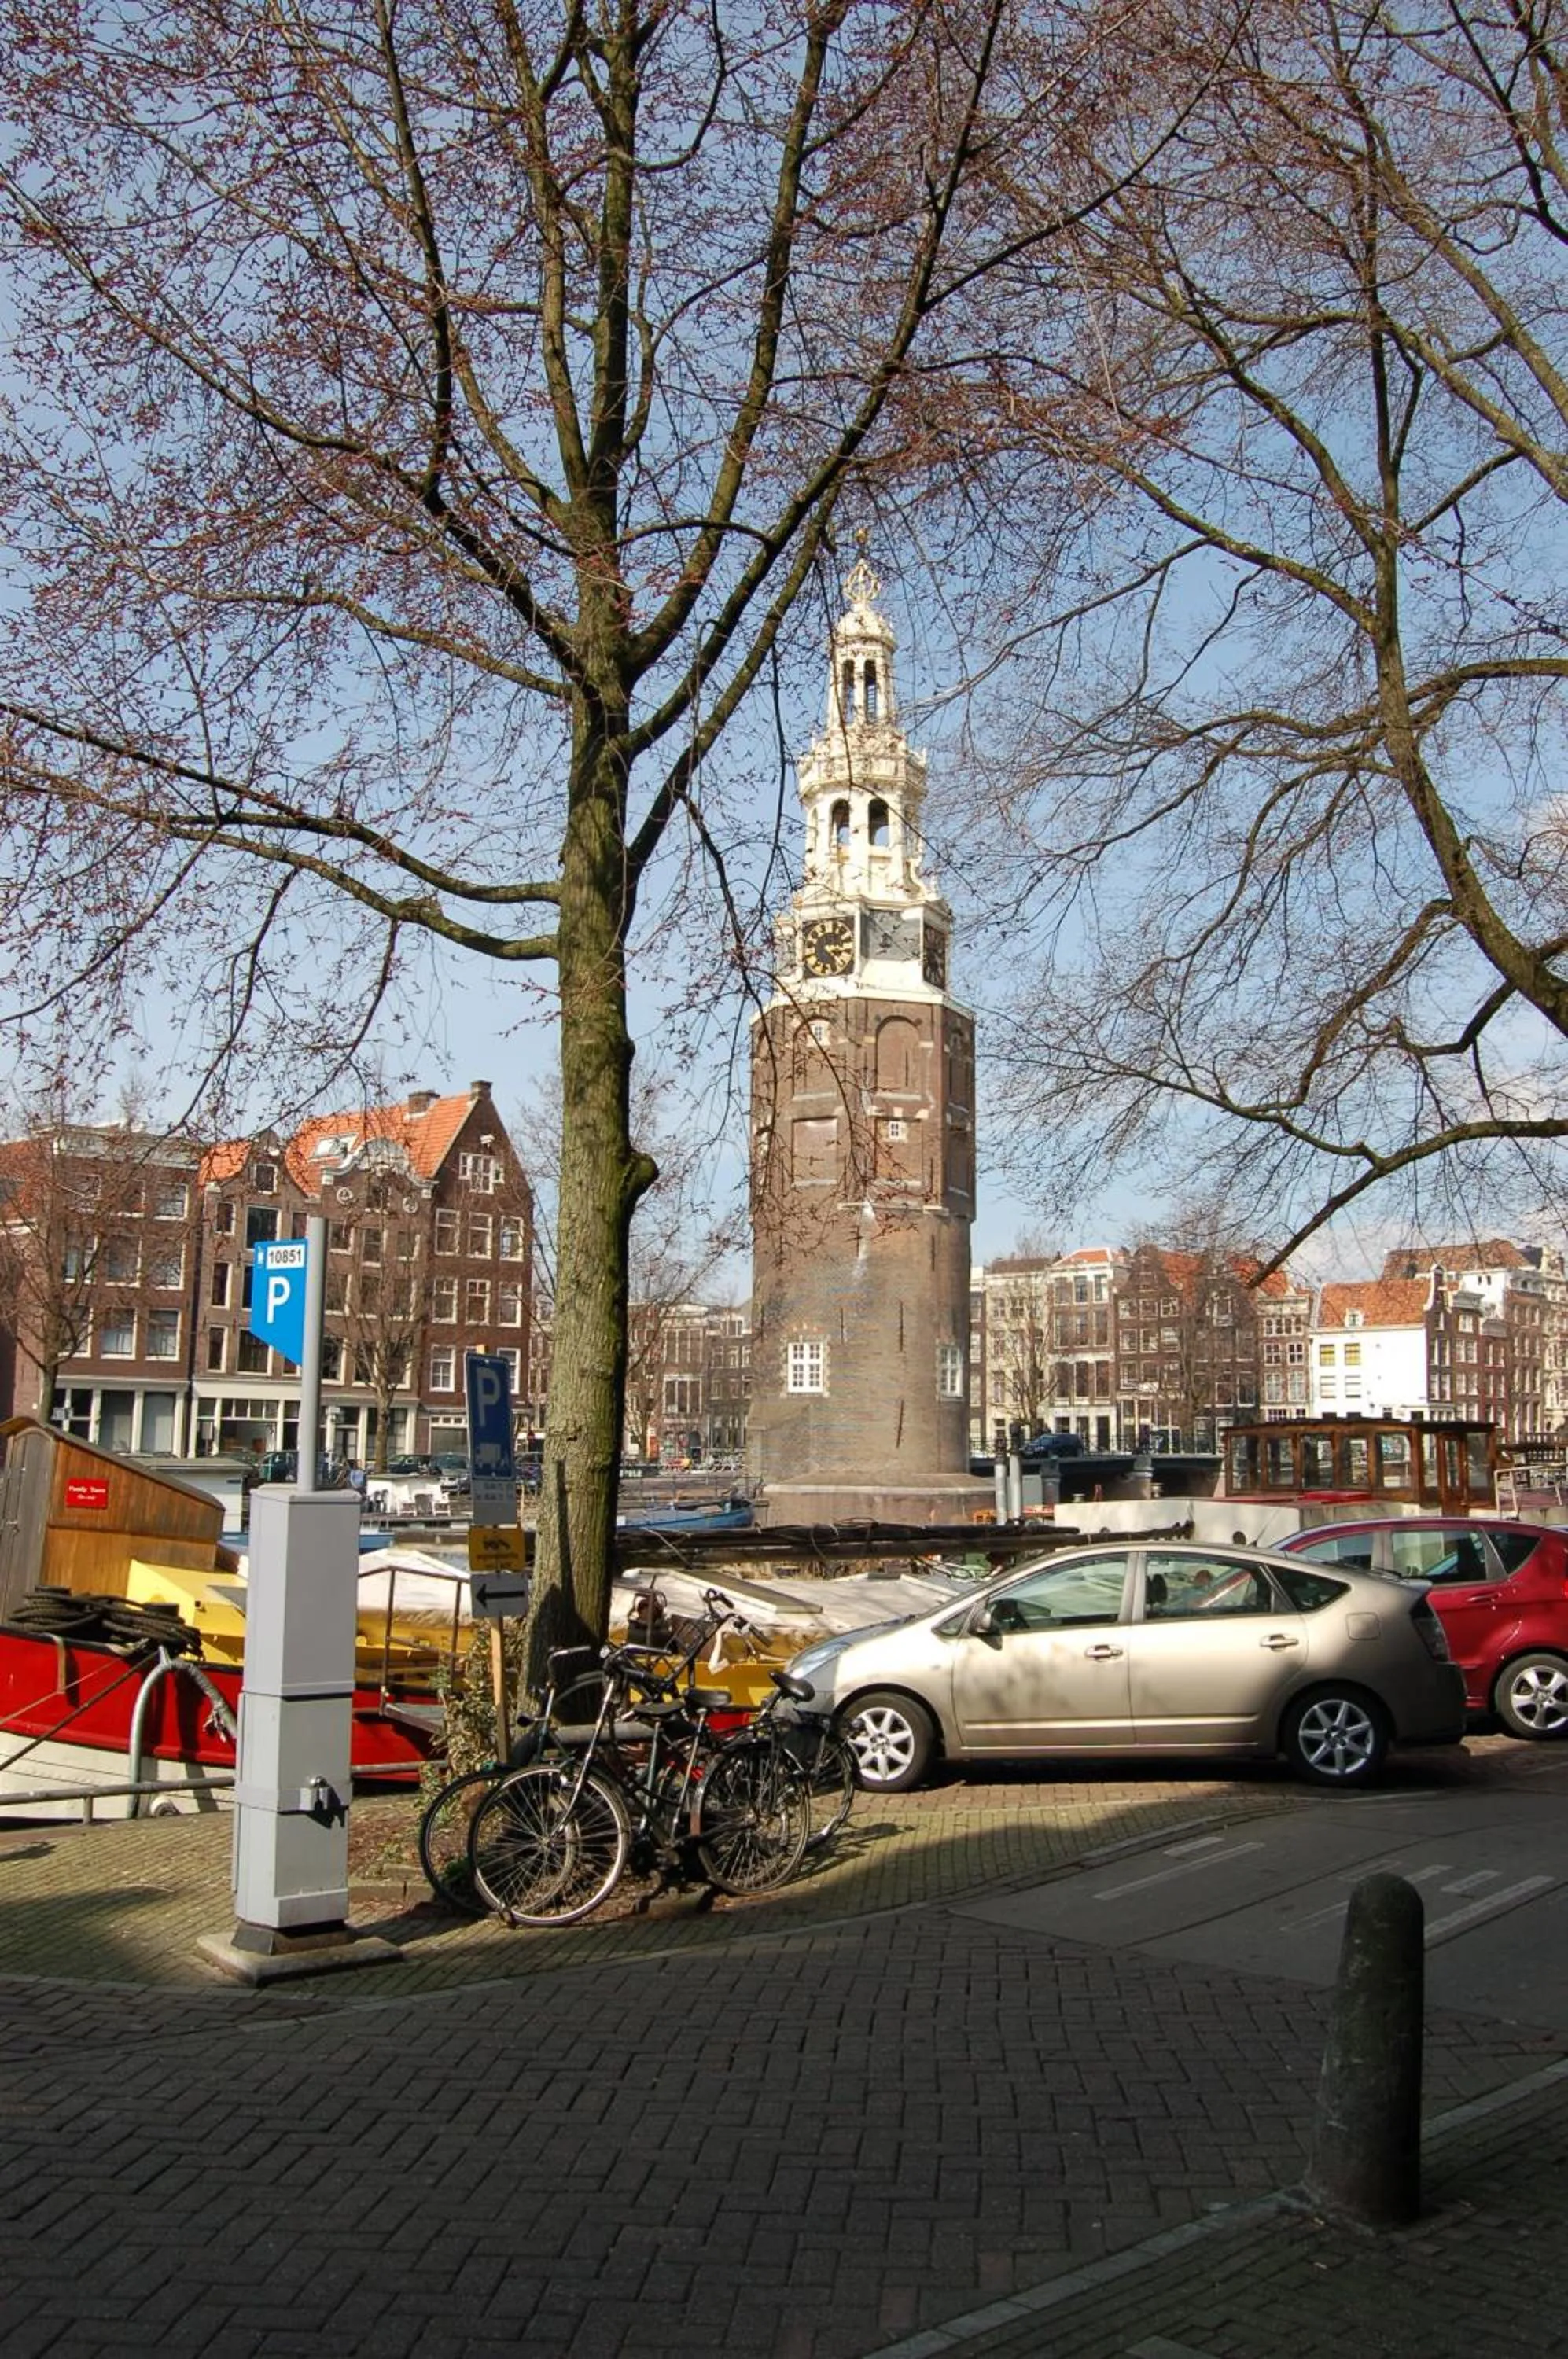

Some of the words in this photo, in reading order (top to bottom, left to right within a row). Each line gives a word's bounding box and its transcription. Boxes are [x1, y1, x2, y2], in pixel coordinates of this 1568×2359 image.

[269, 1249, 301, 1264] 10851
[267, 1276, 291, 1324] P
[477, 1367, 501, 1427] P
